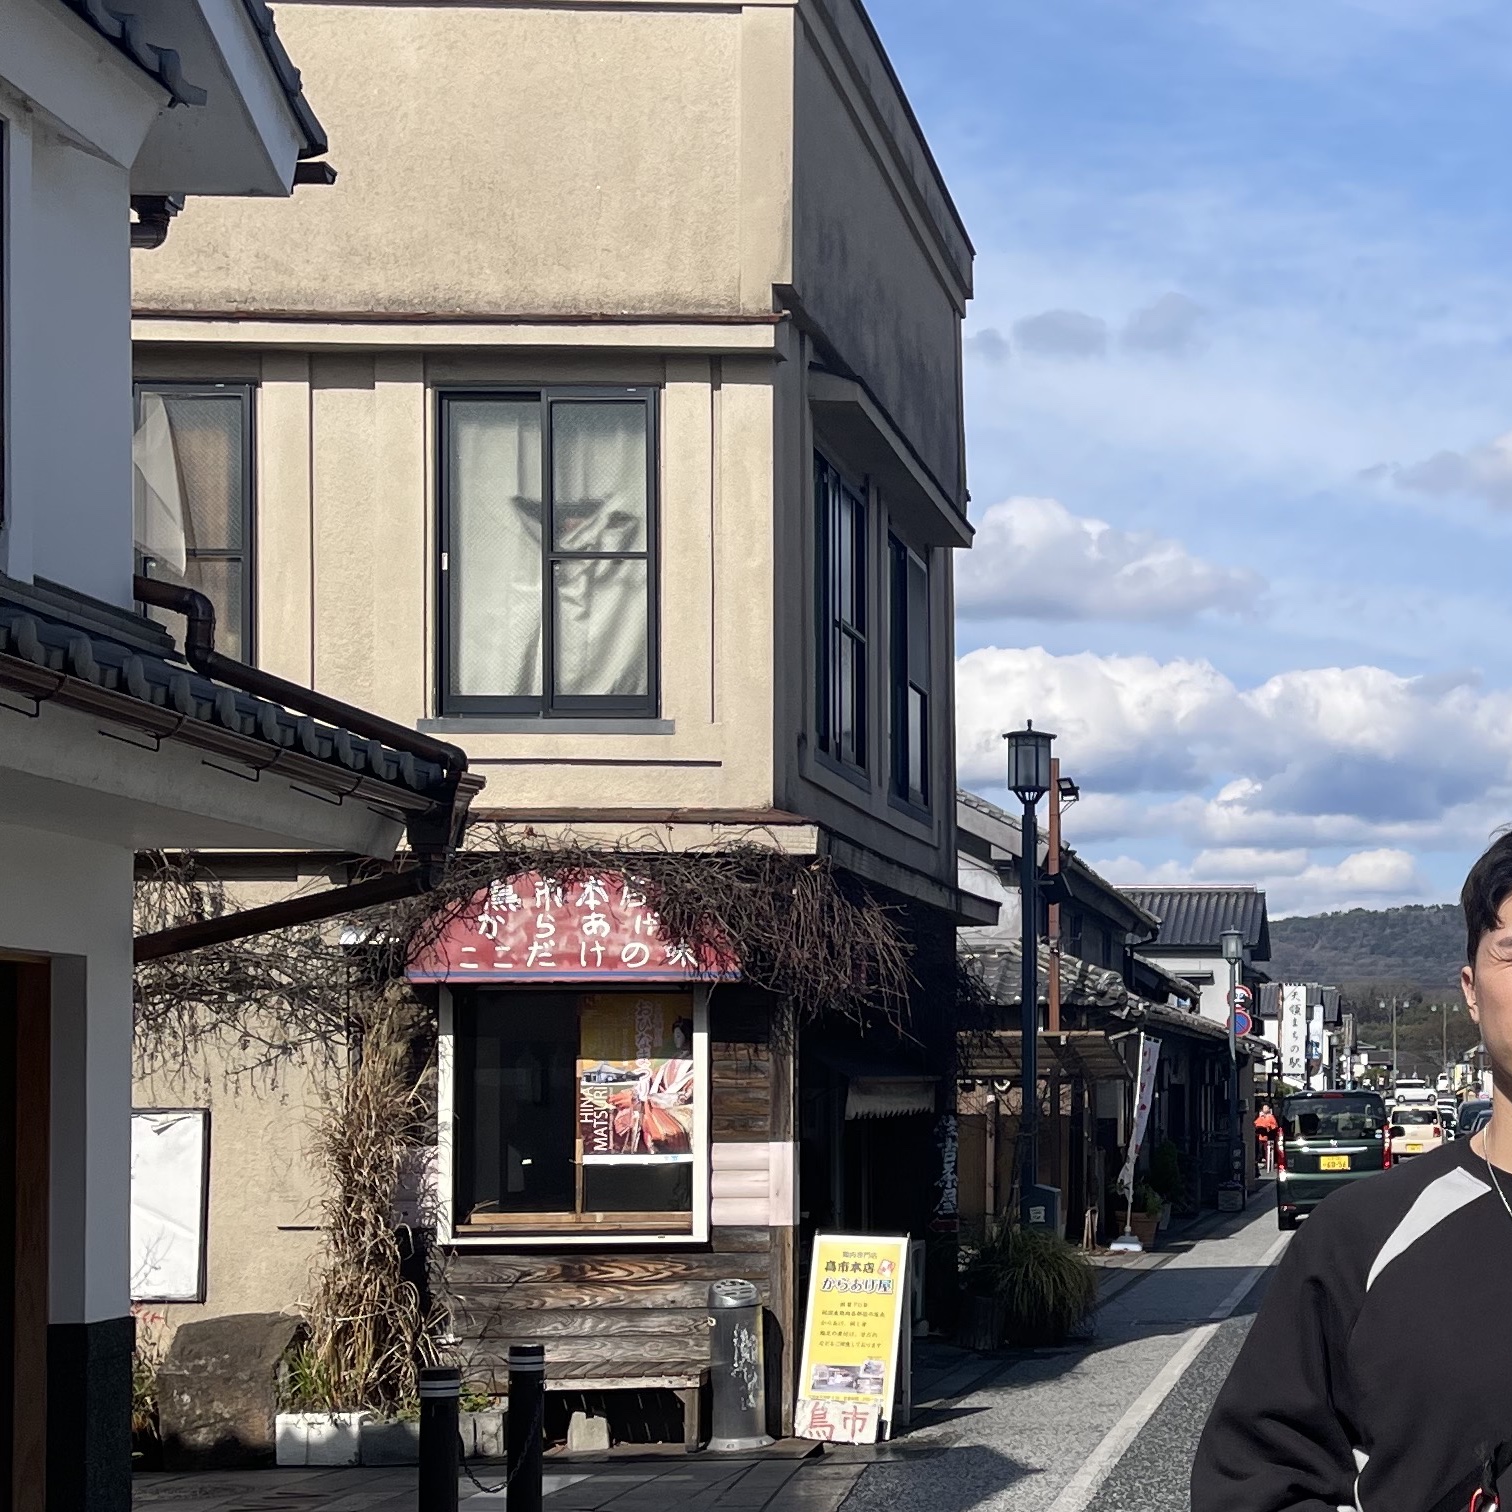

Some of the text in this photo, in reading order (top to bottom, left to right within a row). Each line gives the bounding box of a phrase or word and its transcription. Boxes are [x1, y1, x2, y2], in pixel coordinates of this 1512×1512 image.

[477, 911, 661, 940] からあげ
[459, 937, 699, 969] ここだけの味
[579, 1085, 594, 1123] HINA
[593, 1086, 609, 1151] MATSURI
[824, 1260, 875, 1273] 鳥市本店
[808, 1401, 869, 1441] 鳥市
